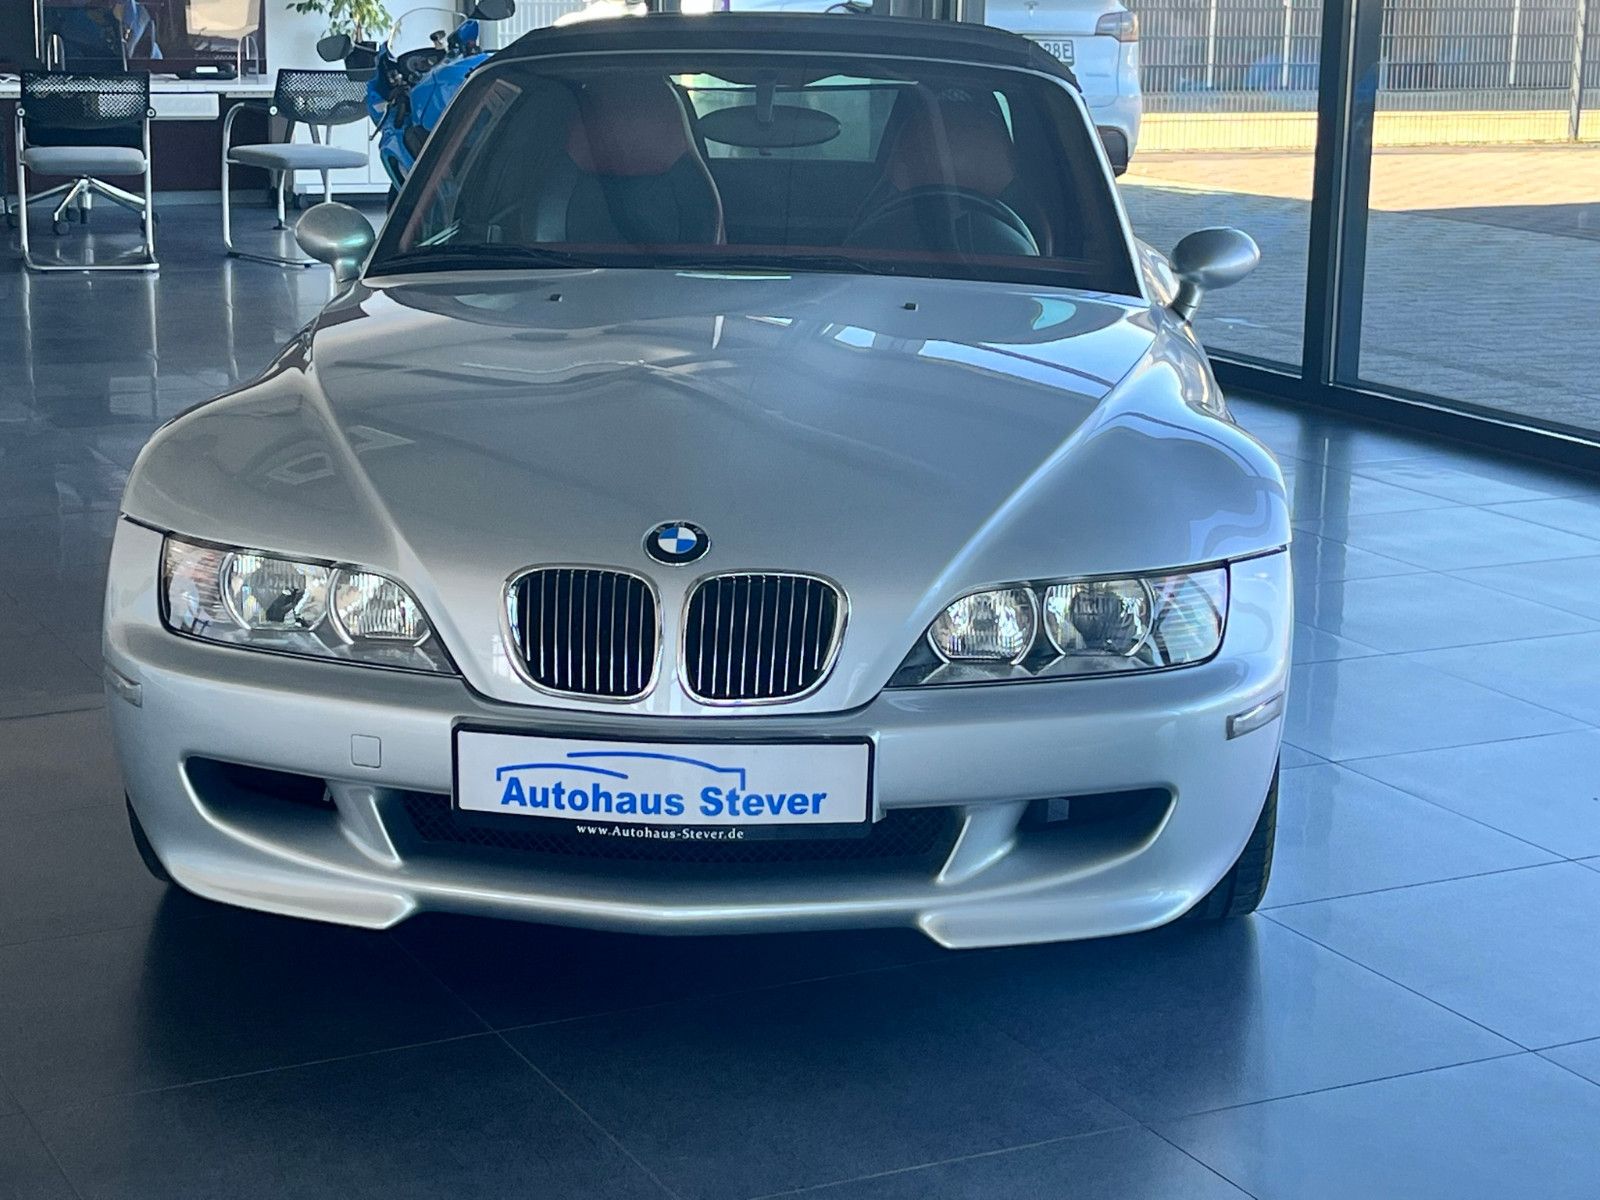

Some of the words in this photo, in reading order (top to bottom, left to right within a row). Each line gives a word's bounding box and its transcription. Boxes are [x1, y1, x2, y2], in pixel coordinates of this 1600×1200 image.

[501, 776, 685, 816] Autohaus
[699, 786, 828, 817] Stever
[576, 824, 745, 840] www.Autohaus-Stever.de
